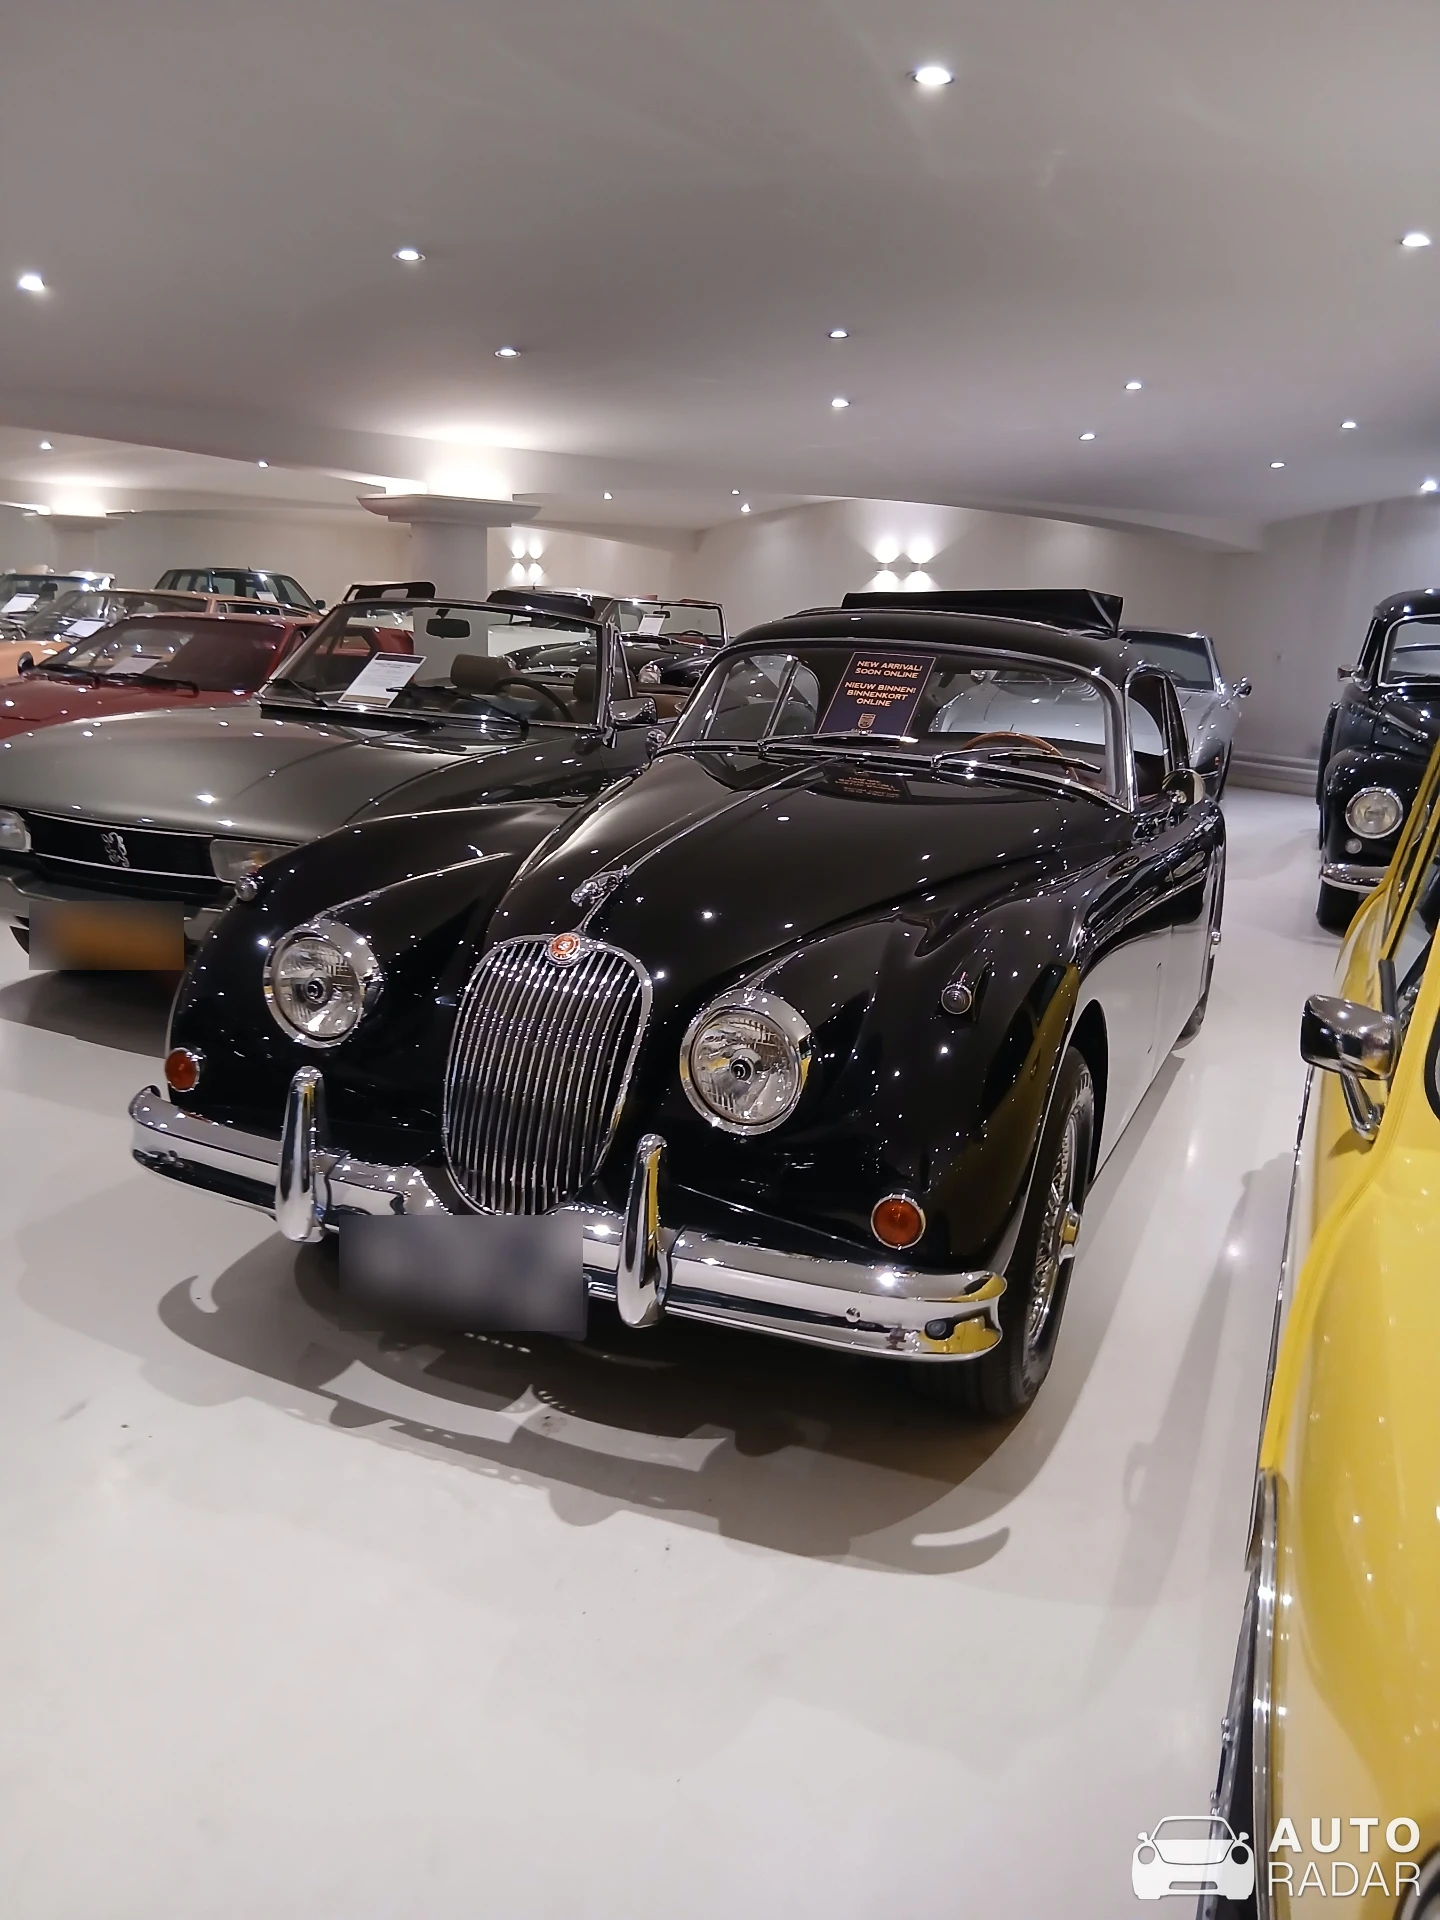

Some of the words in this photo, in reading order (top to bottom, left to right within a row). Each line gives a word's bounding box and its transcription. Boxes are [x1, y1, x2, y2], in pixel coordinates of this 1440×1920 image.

[857, 660, 880, 668] NEW
[880, 662, 923, 672] ARRIVAL!
[855, 667, 882, 676] SOON
[883, 670, 920, 679] ONLINE
[844, 681, 877, 690] NIEUW
[877, 684, 917, 694] BINNEN!
[846, 689, 909, 701] BINNENKORT
[856, 697, 893, 707] ONLINE
